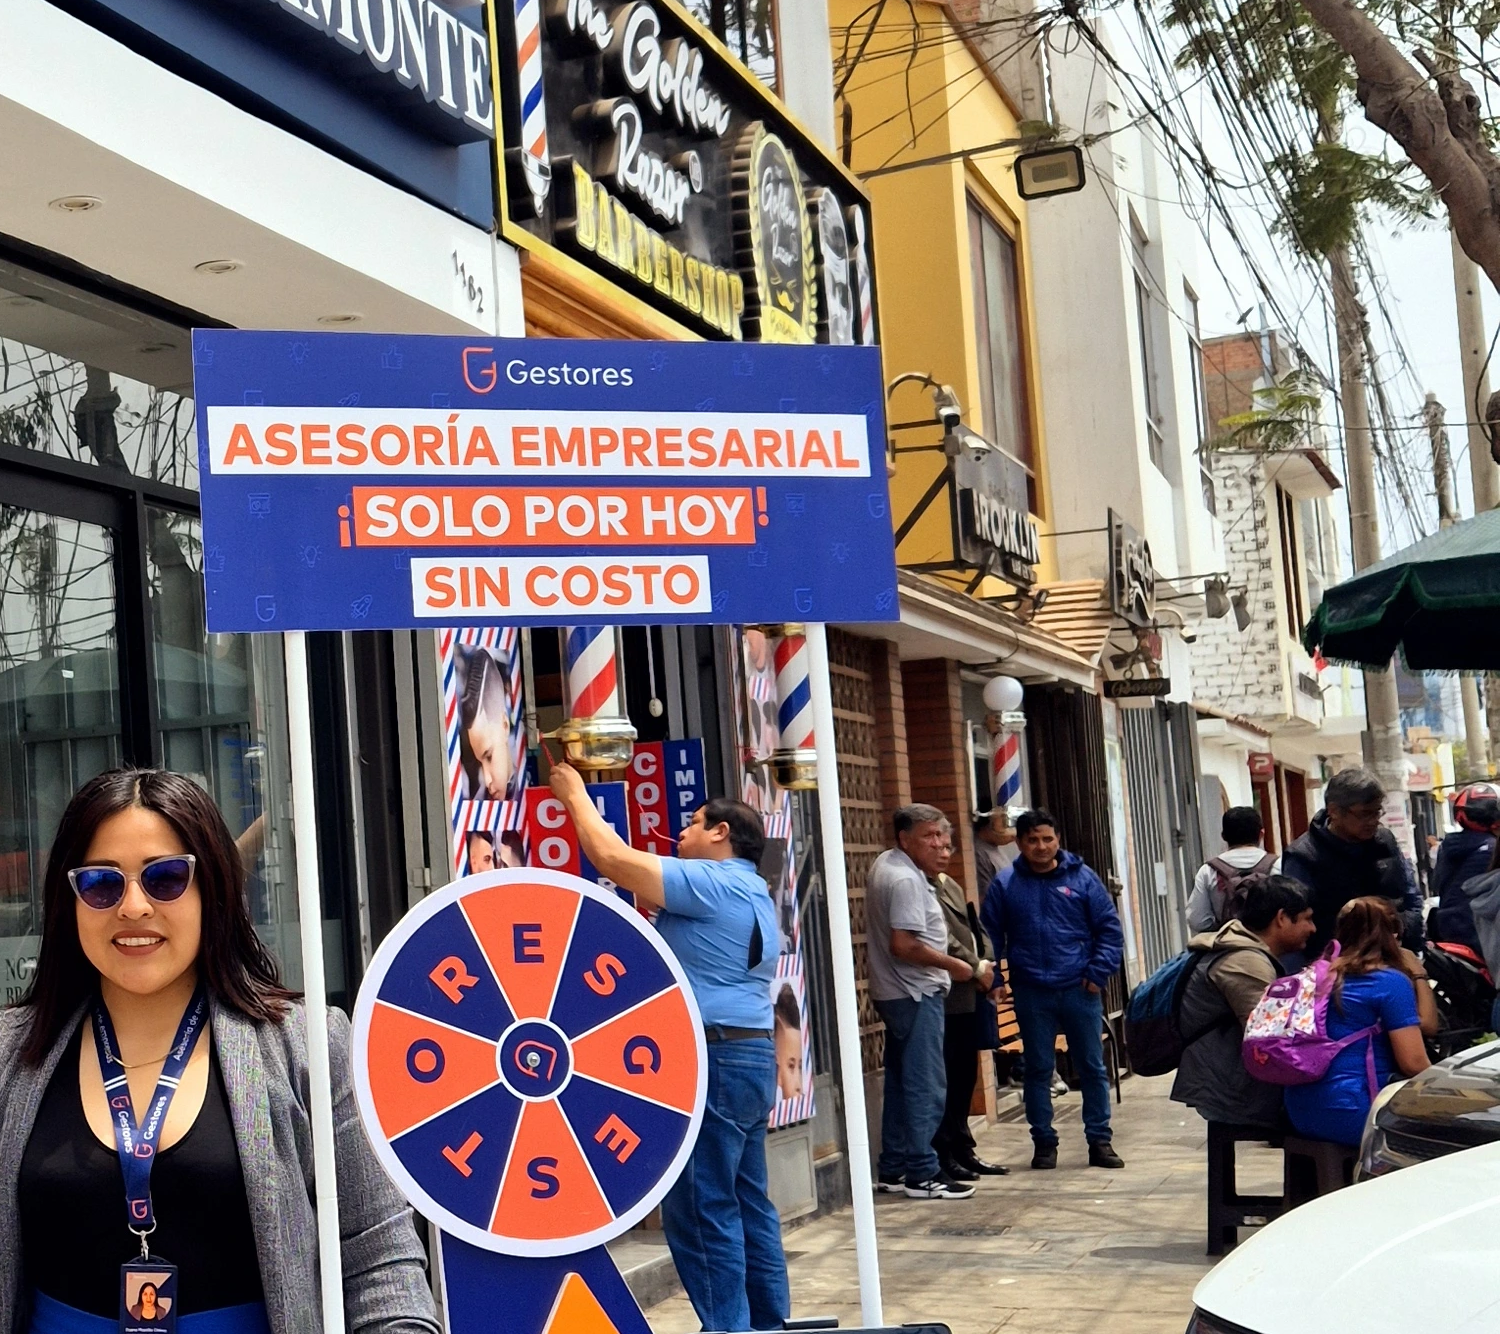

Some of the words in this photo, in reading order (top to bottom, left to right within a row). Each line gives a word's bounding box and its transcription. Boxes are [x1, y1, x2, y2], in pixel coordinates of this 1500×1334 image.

[623, 5, 731, 138] Golden
[612, 103, 690, 224] Razor
[573, 161, 744, 341] BARBERSHOP
[505, 358, 633, 388] Gestores
[222, 414, 499, 467] ASESORÍA
[512, 425, 860, 469] EMPRESARIAL
[524, 494, 631, 537] POR
[425, 566, 512, 609] SIN
[525, 564, 700, 607] COSTO
[118, 1110, 133, 1154] Gestores
[143, 1095, 167, 1140] Gestores
